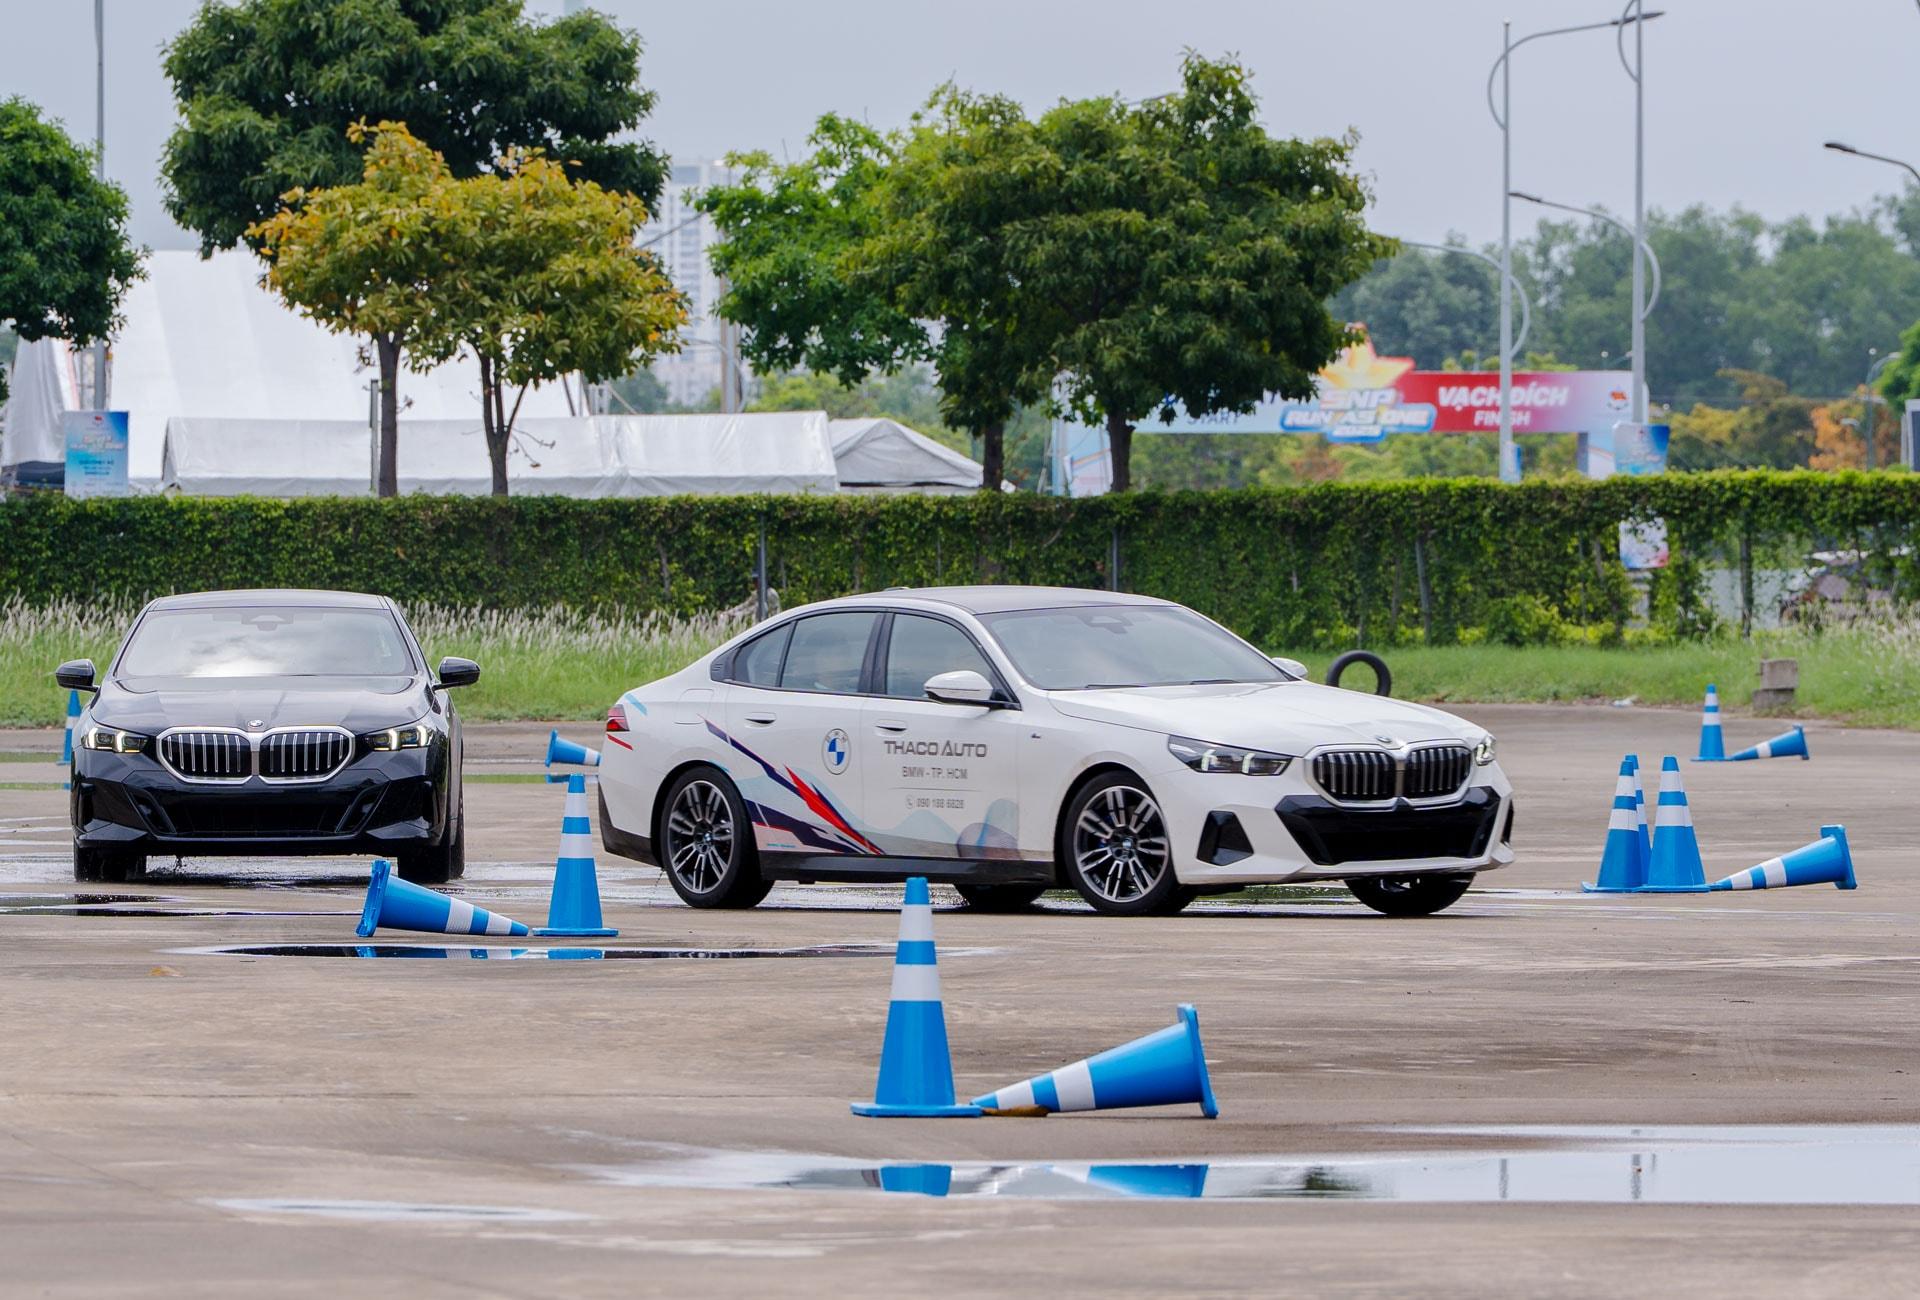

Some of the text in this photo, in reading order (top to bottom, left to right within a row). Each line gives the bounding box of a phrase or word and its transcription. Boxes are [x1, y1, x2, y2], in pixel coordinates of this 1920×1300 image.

[1438, 386, 1501, 412] VẠCH
[1474, 410, 1531, 426] FINSH
[884, 739, 988, 758] THACO AUTO
[902, 766, 924, 778] BMW
[931, 767, 945, 778] TP.
[946, 768, 968, 780] HCM
